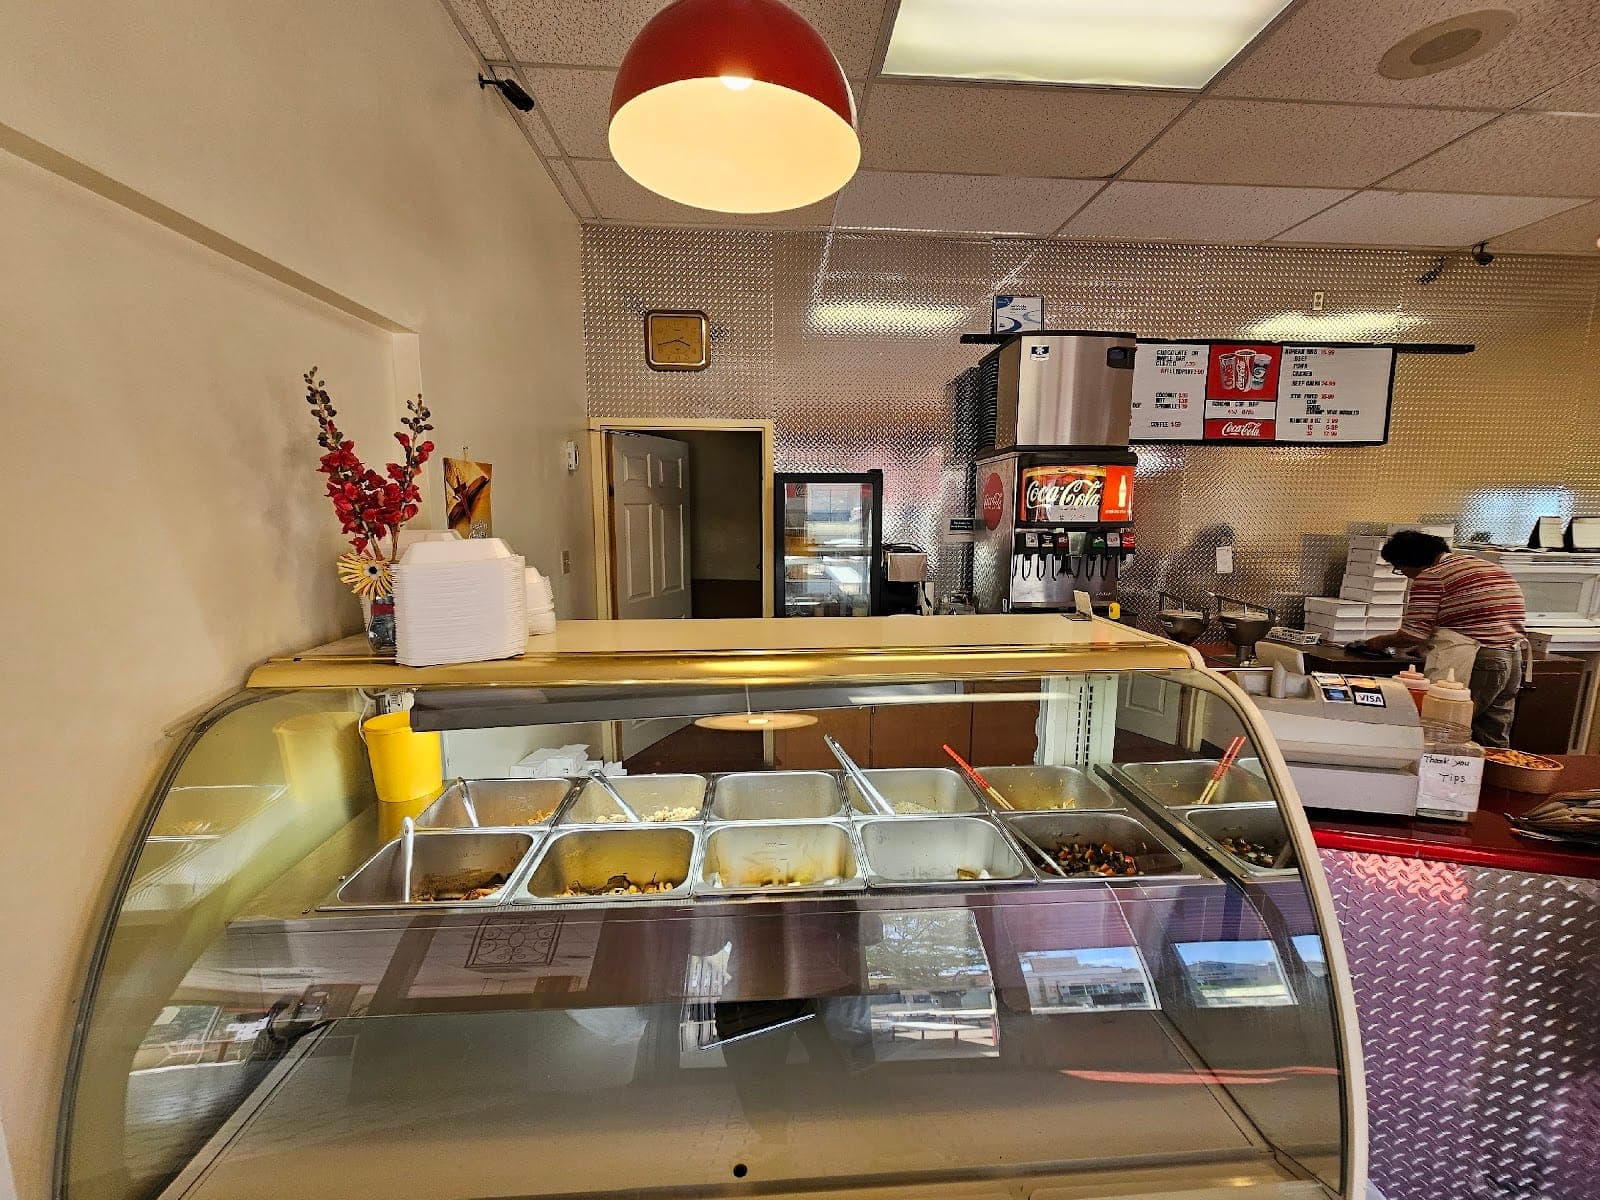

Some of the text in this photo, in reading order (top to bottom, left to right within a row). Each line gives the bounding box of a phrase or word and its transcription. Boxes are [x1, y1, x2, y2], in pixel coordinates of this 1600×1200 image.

[1222, 422, 1262, 436] Coca-Cola
[1026, 479, 1104, 508] Coca-Cola
[1359, 695, 1382, 703] VISA
[1423, 754, 1471, 768] Thank you
[1437, 772, 1466, 785] Tips
